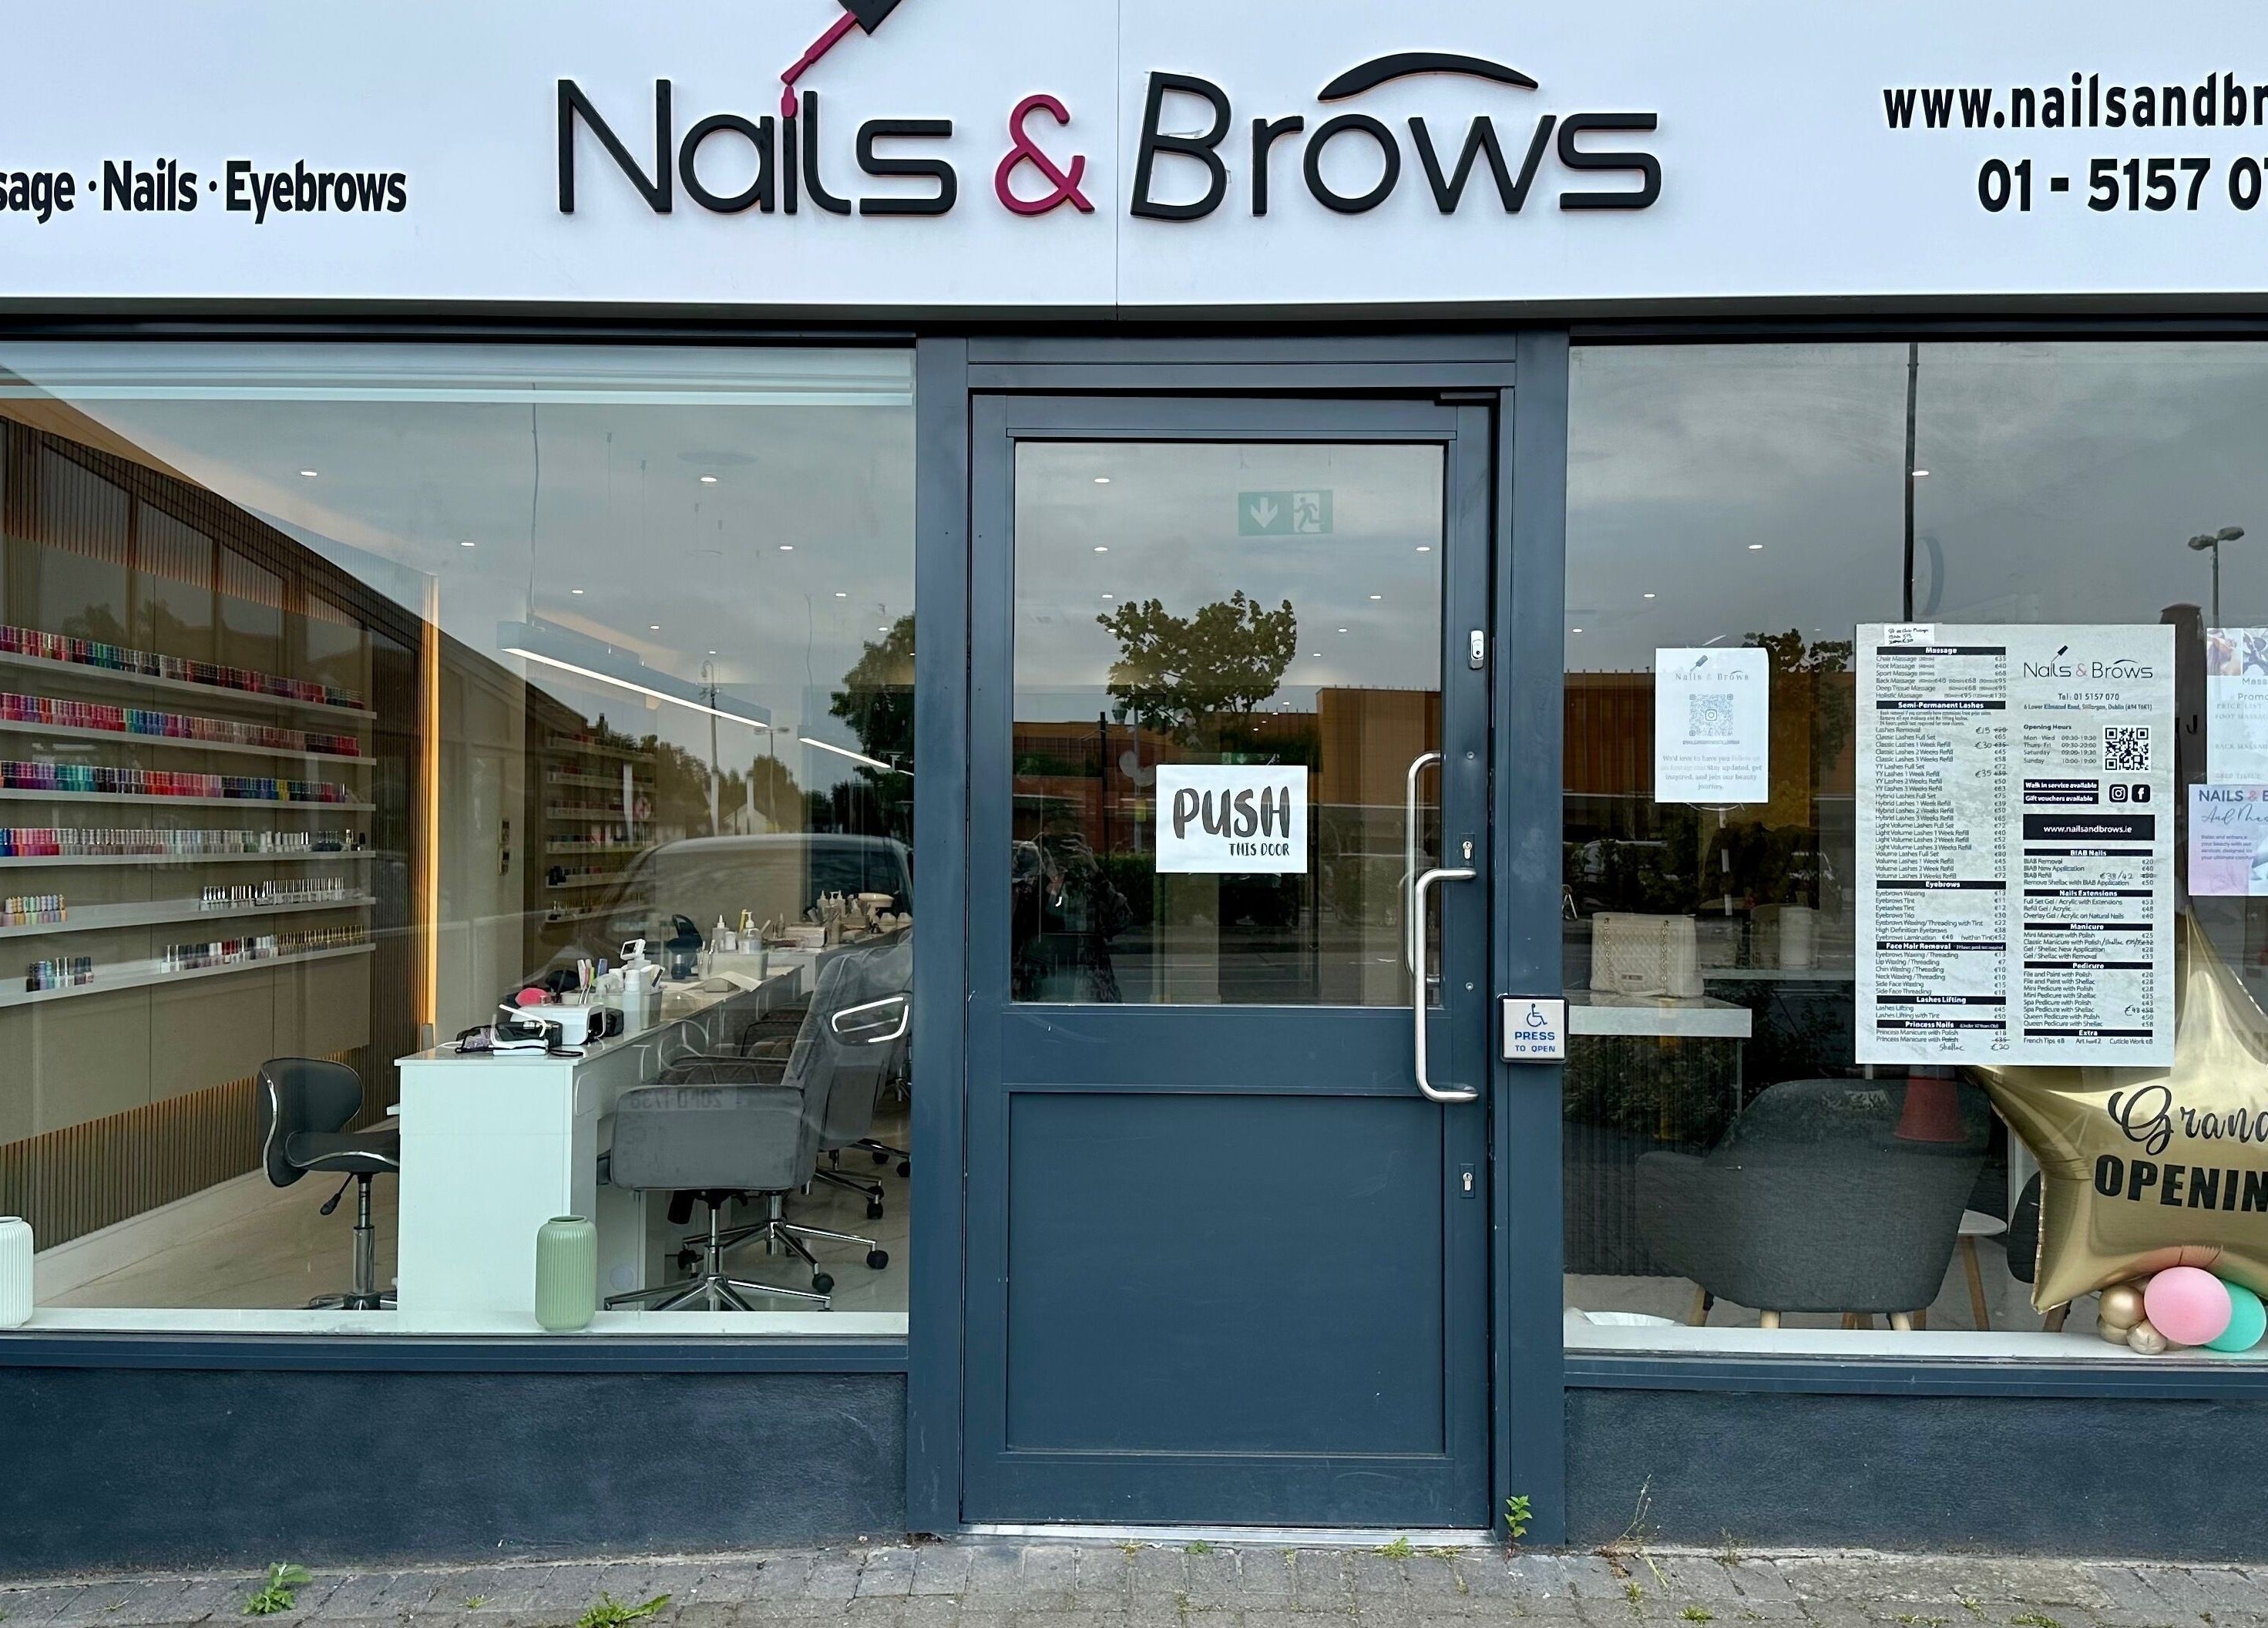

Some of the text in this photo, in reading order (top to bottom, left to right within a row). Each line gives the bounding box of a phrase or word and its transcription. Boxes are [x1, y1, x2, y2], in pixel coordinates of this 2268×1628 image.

[558, 71, 1661, 221] Nails & Brows
[103, 159, 198, 211] Nails
[226, 160, 407, 224] Eyebrows
[1978, 158, 2031, 213] 01
[2087, 157, 2211, 212] 5157
[2228, 156, 2268, 211] 0
[2024, 662, 2152, 678] Nails & Brows
[1173, 786, 1290, 839] PUSH
[2199, 790, 2243, 802] NAILS
[1229, 843, 1289, 856] THIS DOOR
